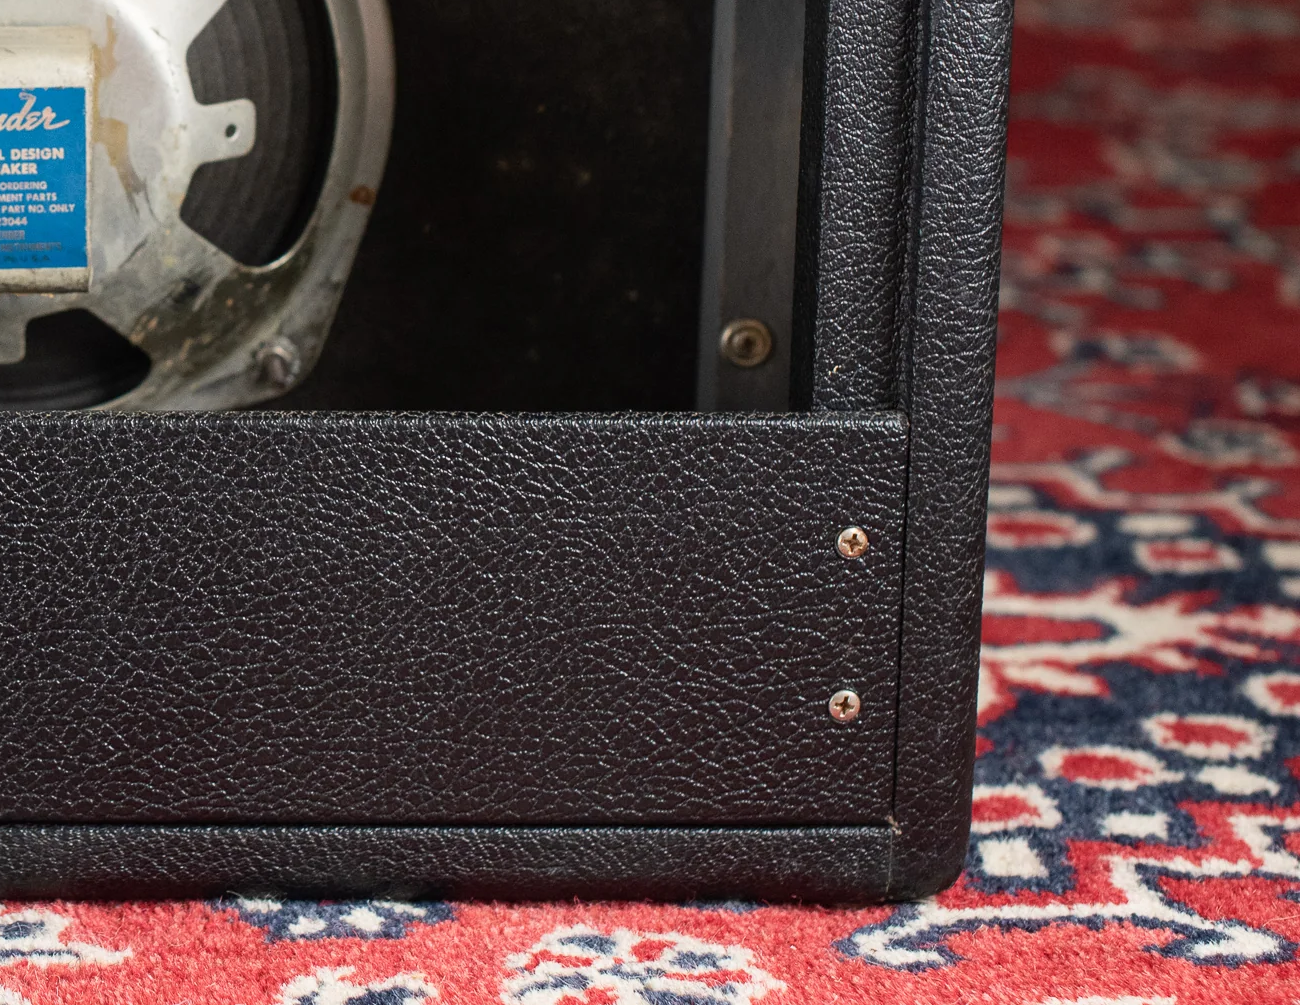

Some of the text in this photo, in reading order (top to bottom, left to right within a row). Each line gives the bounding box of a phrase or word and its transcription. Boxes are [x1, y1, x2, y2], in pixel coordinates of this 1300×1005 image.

[10, 148, 64, 160] DESIGN
[0, 181, 47, 191] ORDERING
[26, 192, 57, 202] PARTS
[1, 205, 25, 213] PART
[28, 204, 46, 213] NO.
[49, 203, 75, 213] ONLY
